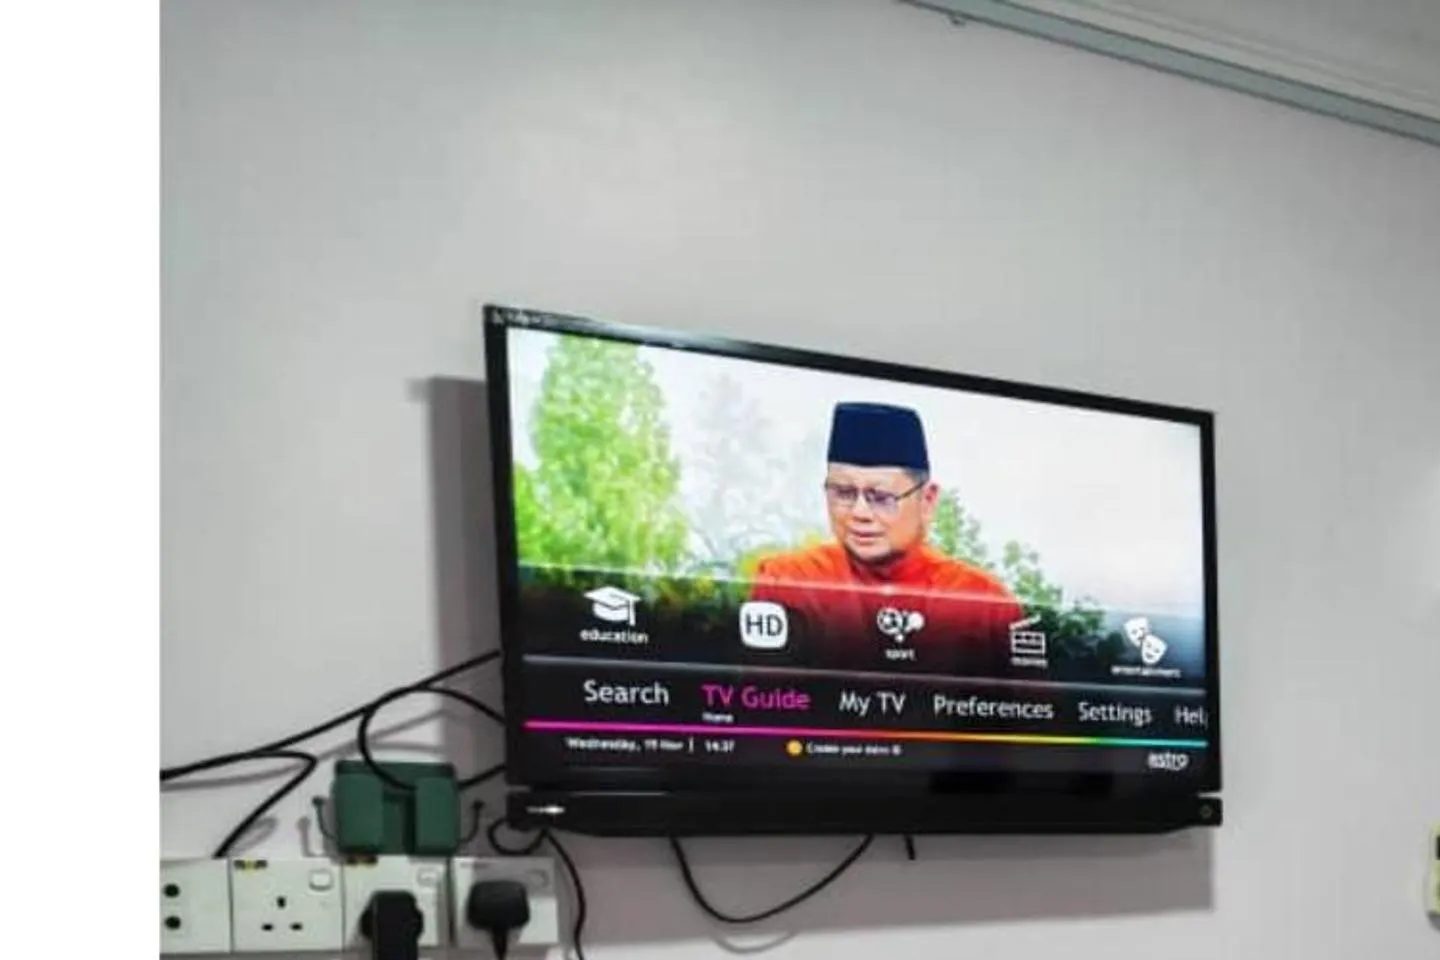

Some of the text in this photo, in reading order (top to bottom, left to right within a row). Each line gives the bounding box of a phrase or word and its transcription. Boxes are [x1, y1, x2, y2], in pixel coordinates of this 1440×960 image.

[580, 628, 649, 644] education
[744, 615, 784, 637] HD
[583, 679, 669, 705] Search
[702, 684, 811, 710] TV Guide
[839, 691, 906, 716] My TV
[933, 695, 1054, 719] Preferences
[1078, 701, 1152, 727] Settings
[1147, 750, 1190, 772] astro
